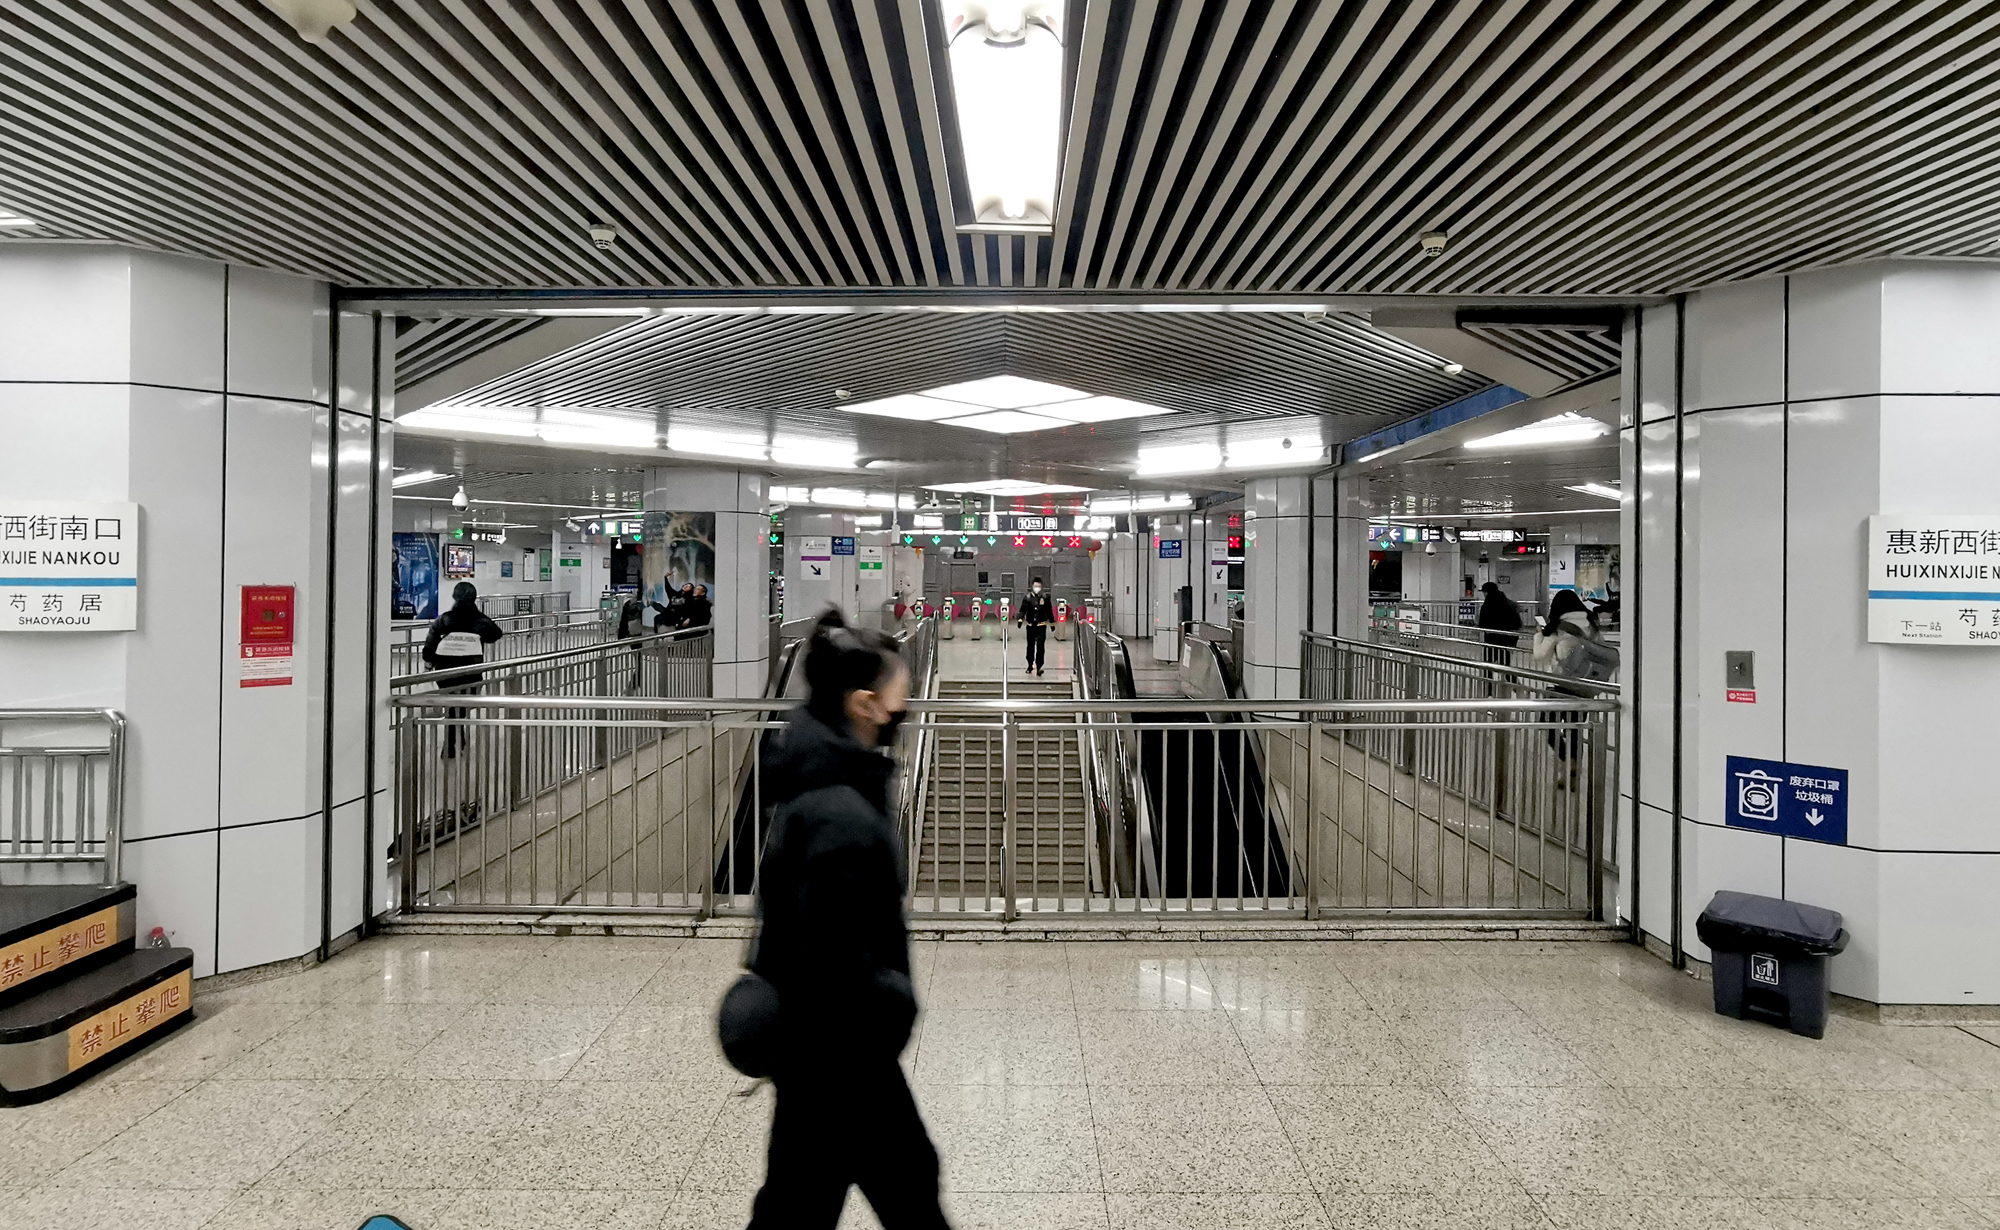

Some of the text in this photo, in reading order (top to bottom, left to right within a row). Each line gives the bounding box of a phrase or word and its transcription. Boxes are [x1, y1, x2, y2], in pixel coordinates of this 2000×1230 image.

[0, 514, 121, 541] 西街南口
[1886, 528, 2000, 555] 惠新西街
[0, 551, 120, 566] XIJIE NANKOU
[1886, 564, 1988, 580] HUIXINXIJIE
[9, 593, 103, 613] 芍药居
[18, 616, 91, 626] SHAOYAOJU
[1900, 620, 1942, 631] 下一站
[1789, 775, 1840, 791] 废弃口罩
[1795, 789, 1834, 805] 垃圾桶
[1, 922, 106, 985] 禁止攀爬
[81, 985, 179, 1057] 禁止攀爬
